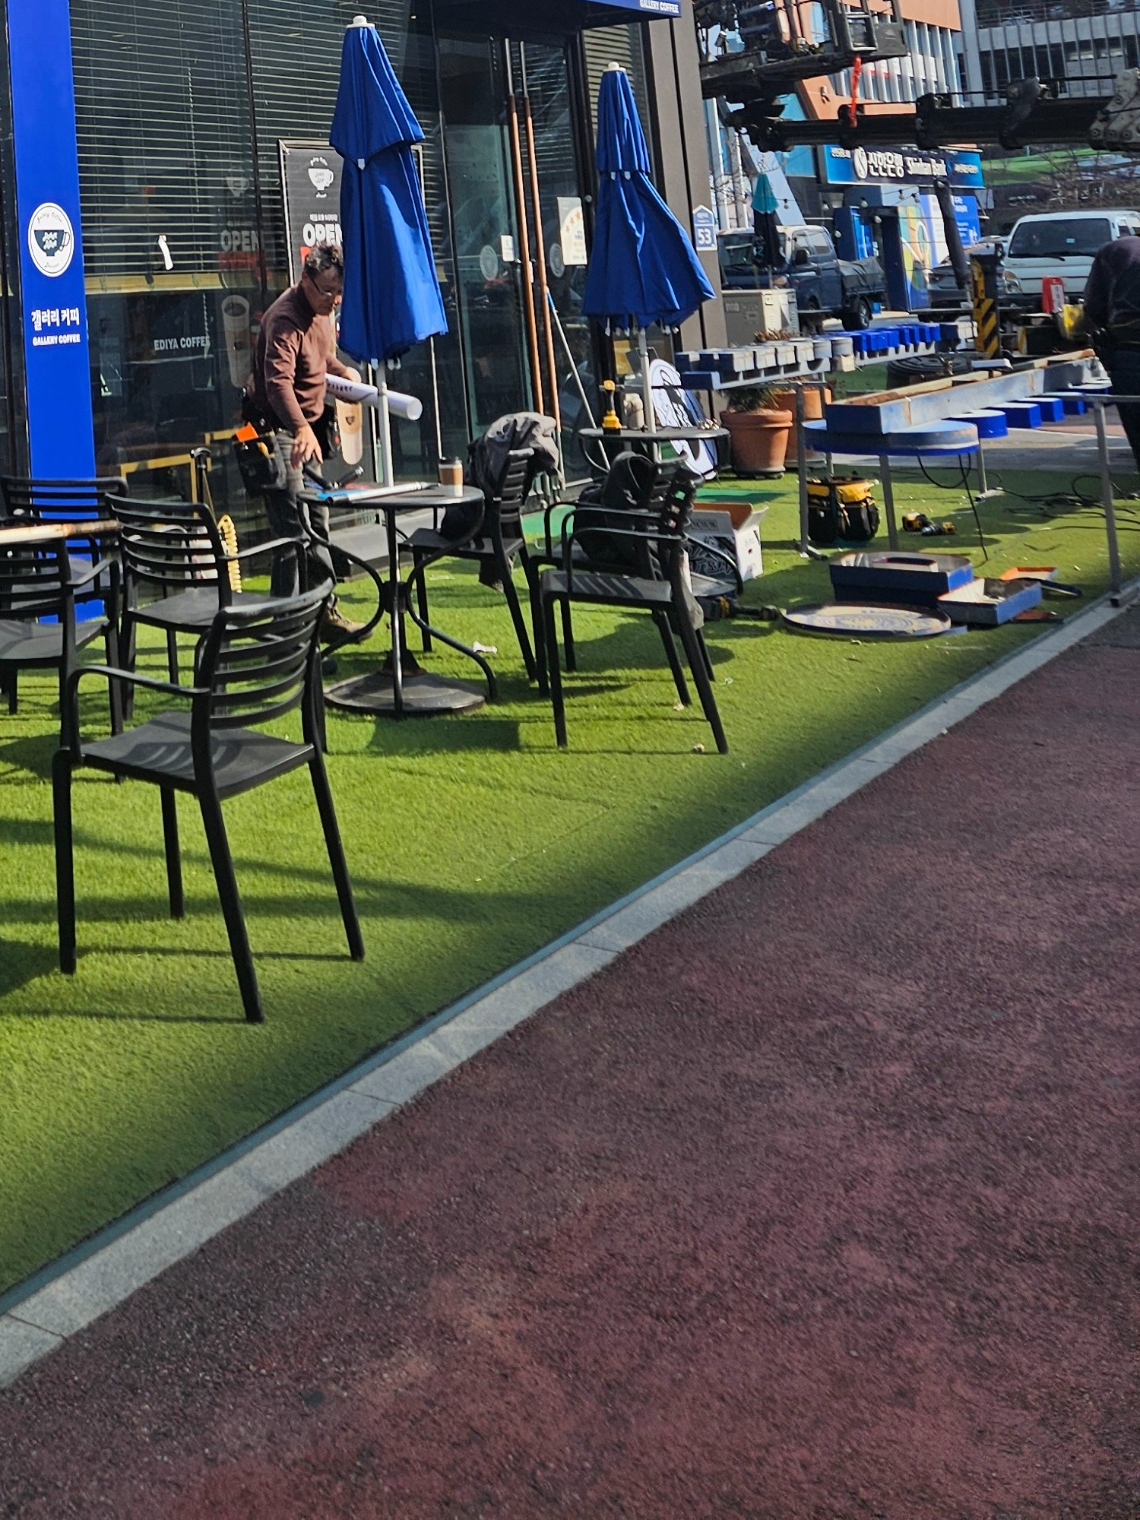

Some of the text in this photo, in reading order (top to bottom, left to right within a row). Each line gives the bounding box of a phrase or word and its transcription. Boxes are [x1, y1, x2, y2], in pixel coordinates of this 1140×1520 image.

[867, 151, 905, 178] 신한은행
[697, 228, 712, 245] 53
[31, 307, 80, 331] 갤러리 커피
[32, 333, 81, 346] GALLERY COFFEE
[153, 338, 179, 351] EDIYA
